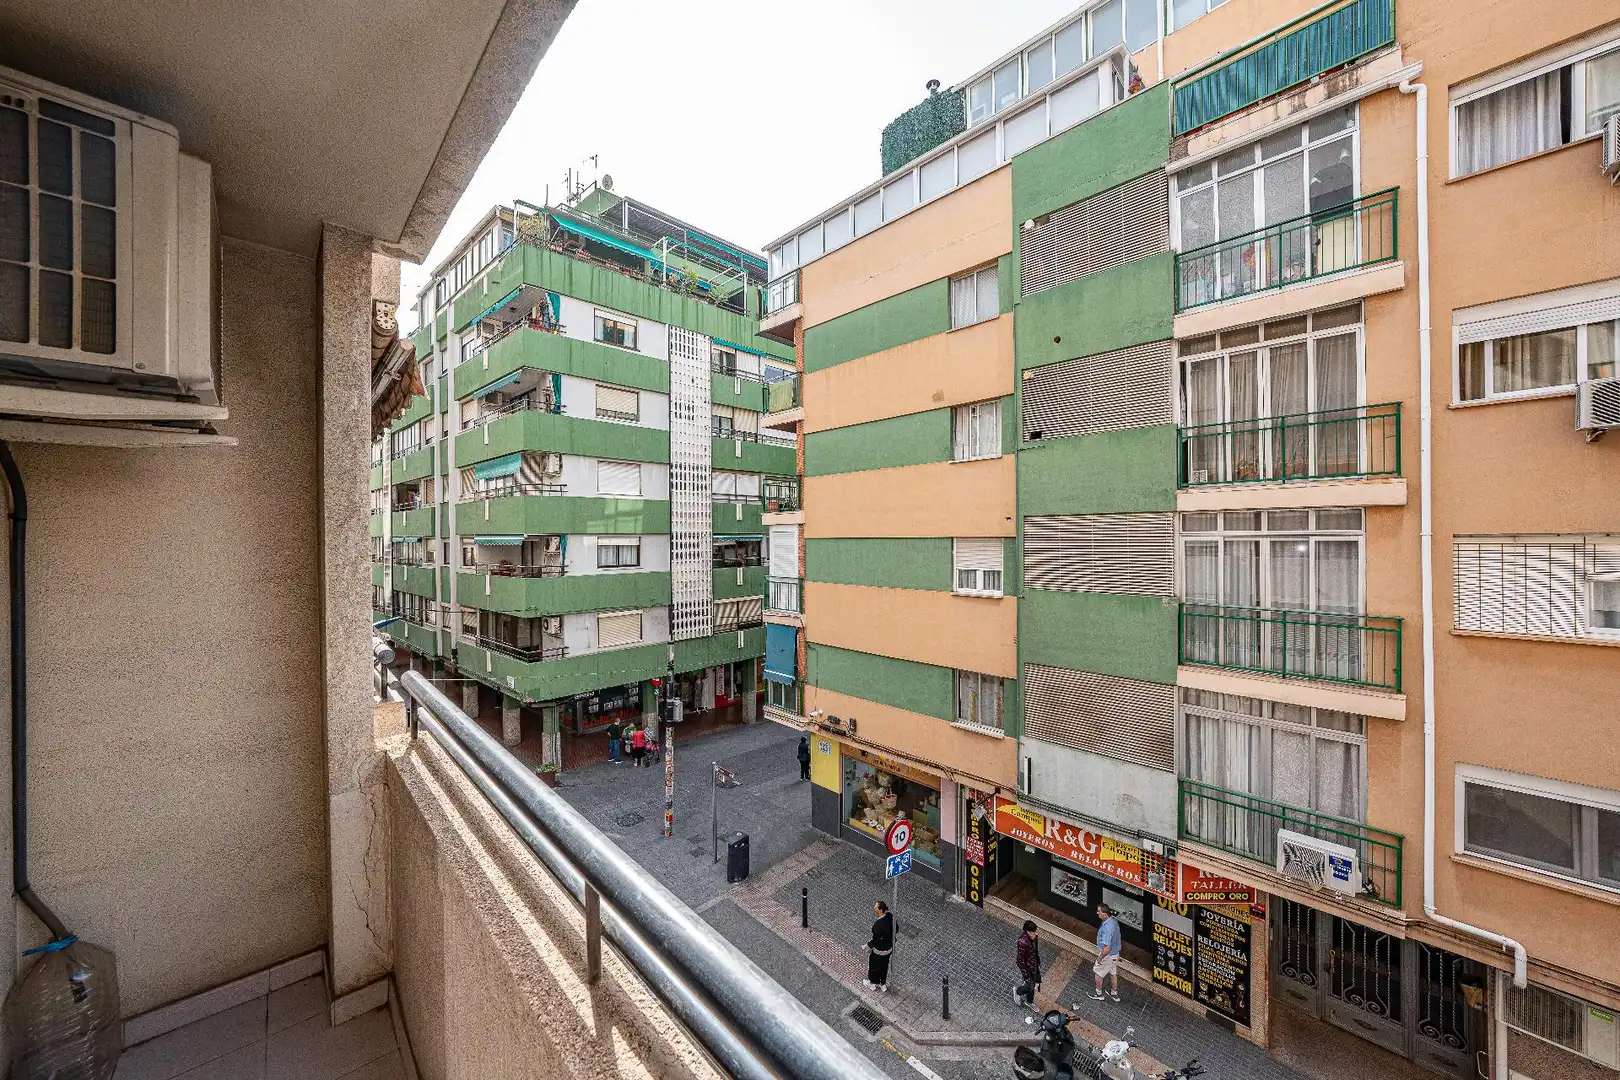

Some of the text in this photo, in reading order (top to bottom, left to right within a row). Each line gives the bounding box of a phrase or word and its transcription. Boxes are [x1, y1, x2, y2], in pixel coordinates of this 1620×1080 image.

[895, 831, 906, 844] 10
[1010, 827, 1055, 850] JOYEROS
[1045, 816, 1098, 854] R&G
[970, 865, 979, 902] ORO
[1190, 881, 1247, 890] TALLER
[1186, 892, 1226, 901] COMPRO
[1229, 892, 1249, 901] ORO
[1200, 909, 1246, 933] JOYERÍA
[1152, 932, 1192, 957] RELOJES
[1154, 923, 1191, 946] OUTLET
[1197, 934, 1247, 962] RELOJERÍA
